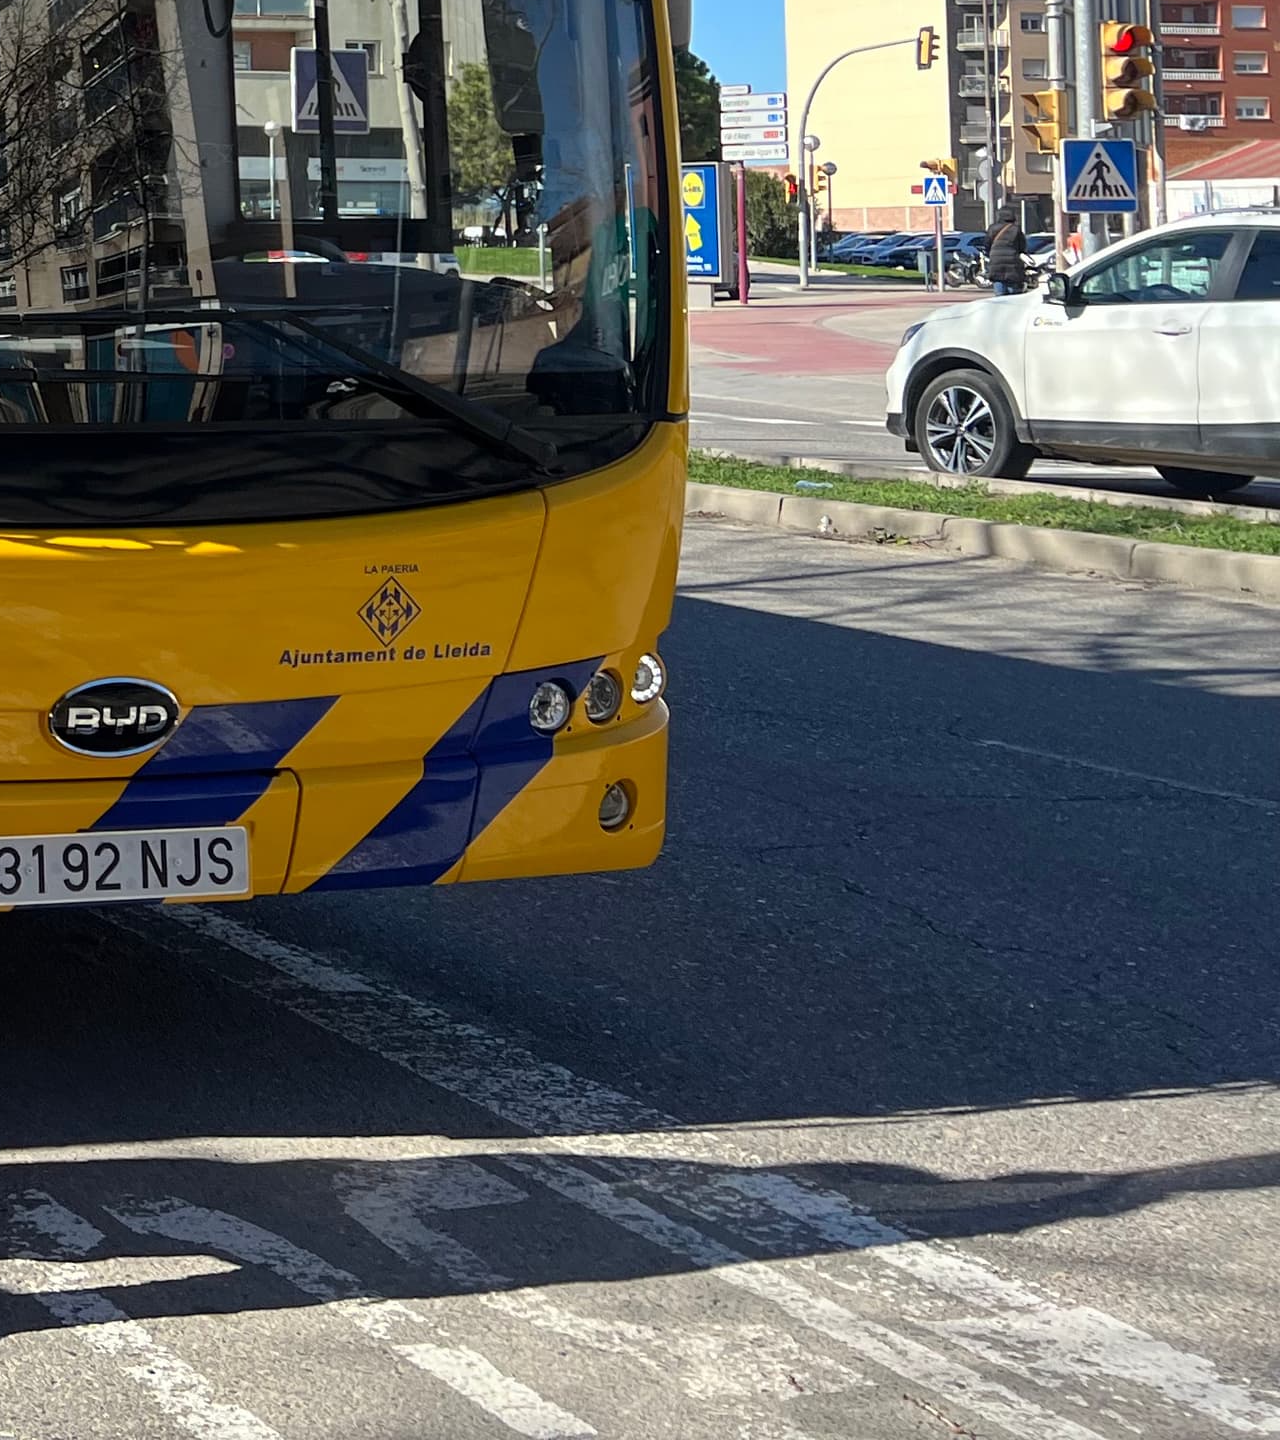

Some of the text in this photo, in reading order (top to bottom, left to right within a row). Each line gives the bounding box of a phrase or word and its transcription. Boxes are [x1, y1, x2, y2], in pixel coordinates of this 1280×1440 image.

[364, 564, 419, 574] LA PAERIA
[279, 642, 491, 668] Ajuntament de Lleida
[66, 705, 168, 735] BYD
[140, 837, 234, 889] NJS
